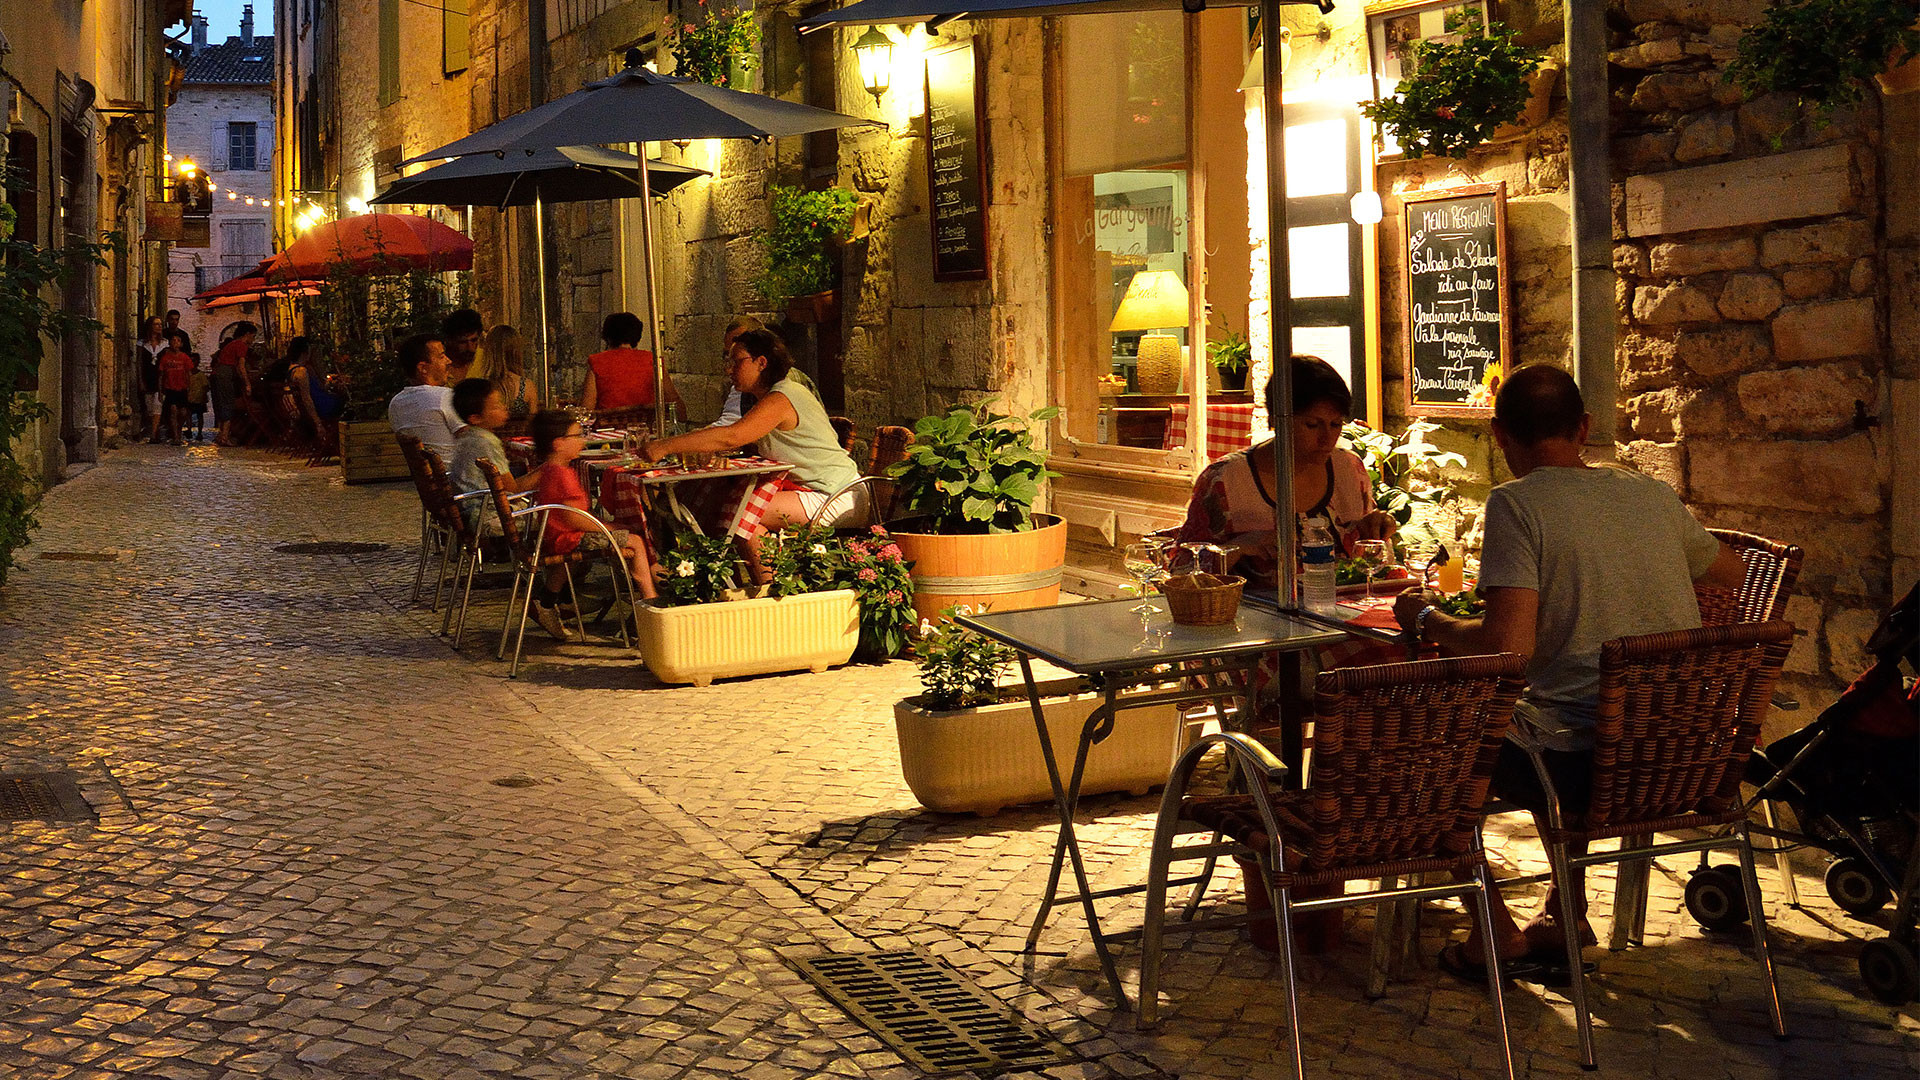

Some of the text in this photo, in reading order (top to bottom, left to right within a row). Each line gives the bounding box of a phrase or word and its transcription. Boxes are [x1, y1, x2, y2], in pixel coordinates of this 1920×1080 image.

[1423, 208, 1449, 233] MENU
[1411, 246, 1451, 274] Salade
[1452, 248, 1466, 269] de
[1456, 280, 1470, 291] au
[1470, 271, 1495, 302] four
[1460, 303, 1472, 322] de
